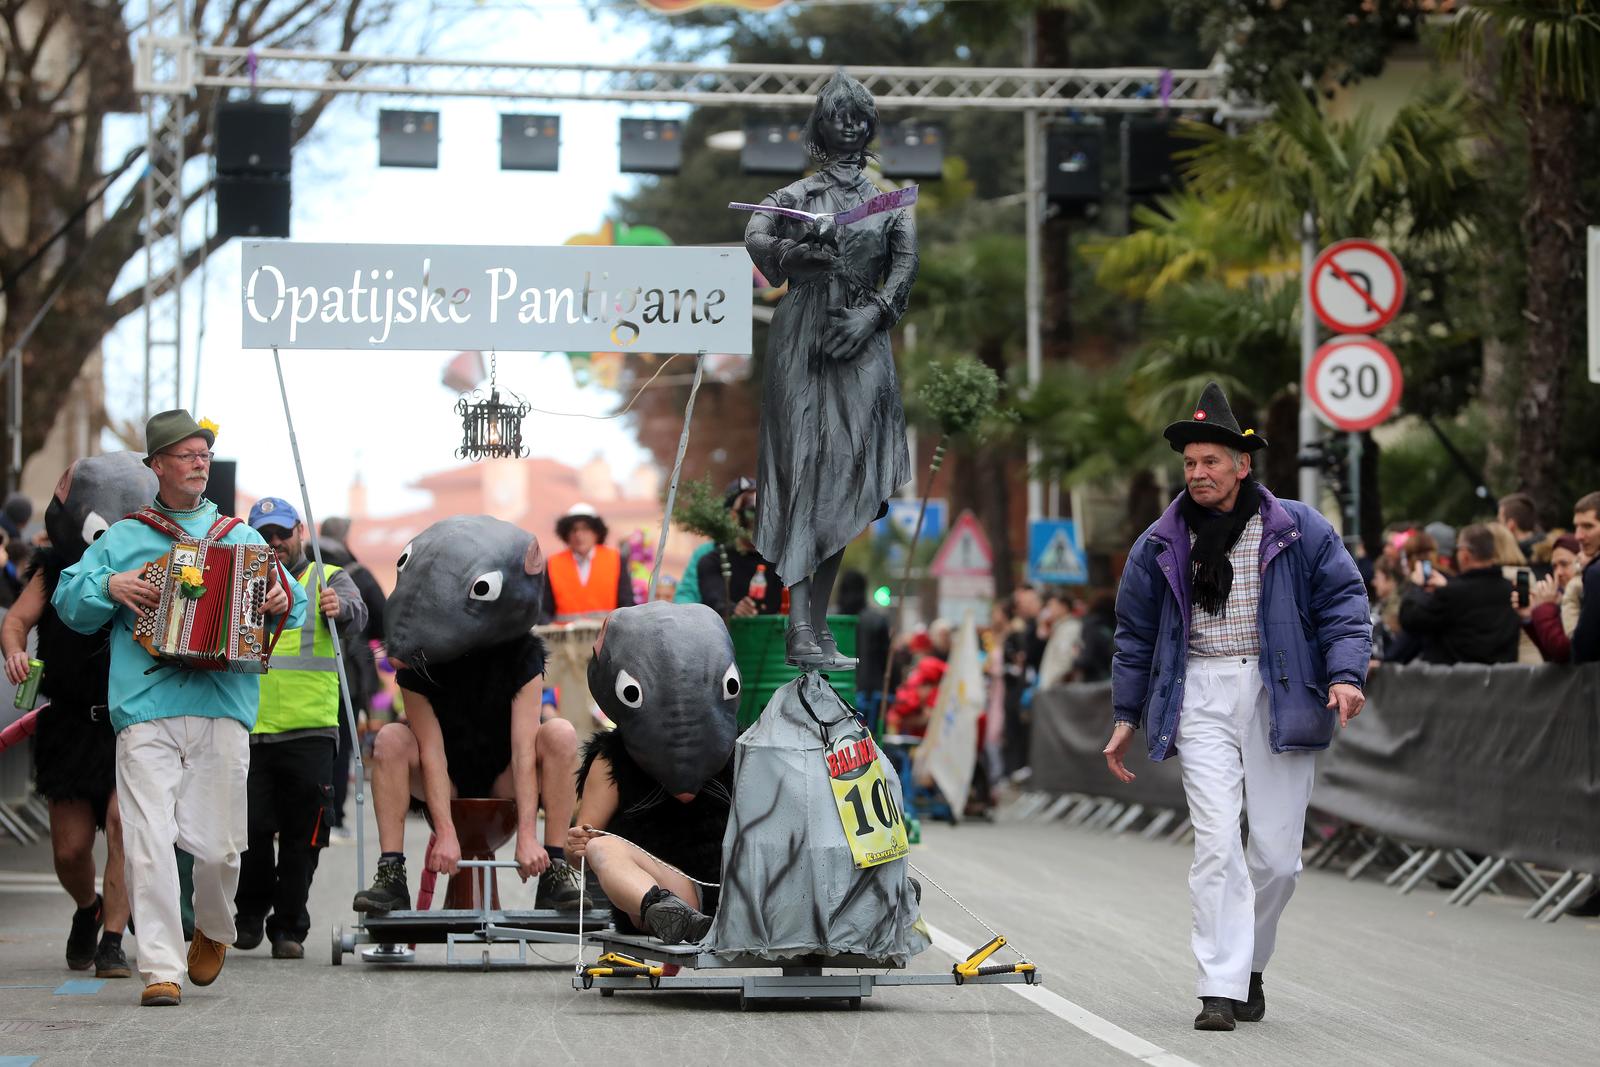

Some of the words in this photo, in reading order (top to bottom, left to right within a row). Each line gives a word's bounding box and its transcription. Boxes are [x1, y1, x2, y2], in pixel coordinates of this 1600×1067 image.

[245, 257, 472, 345] Opatijske
[486, 267, 727, 347] Pantigane
[1329, 365, 1379, 399] 30
